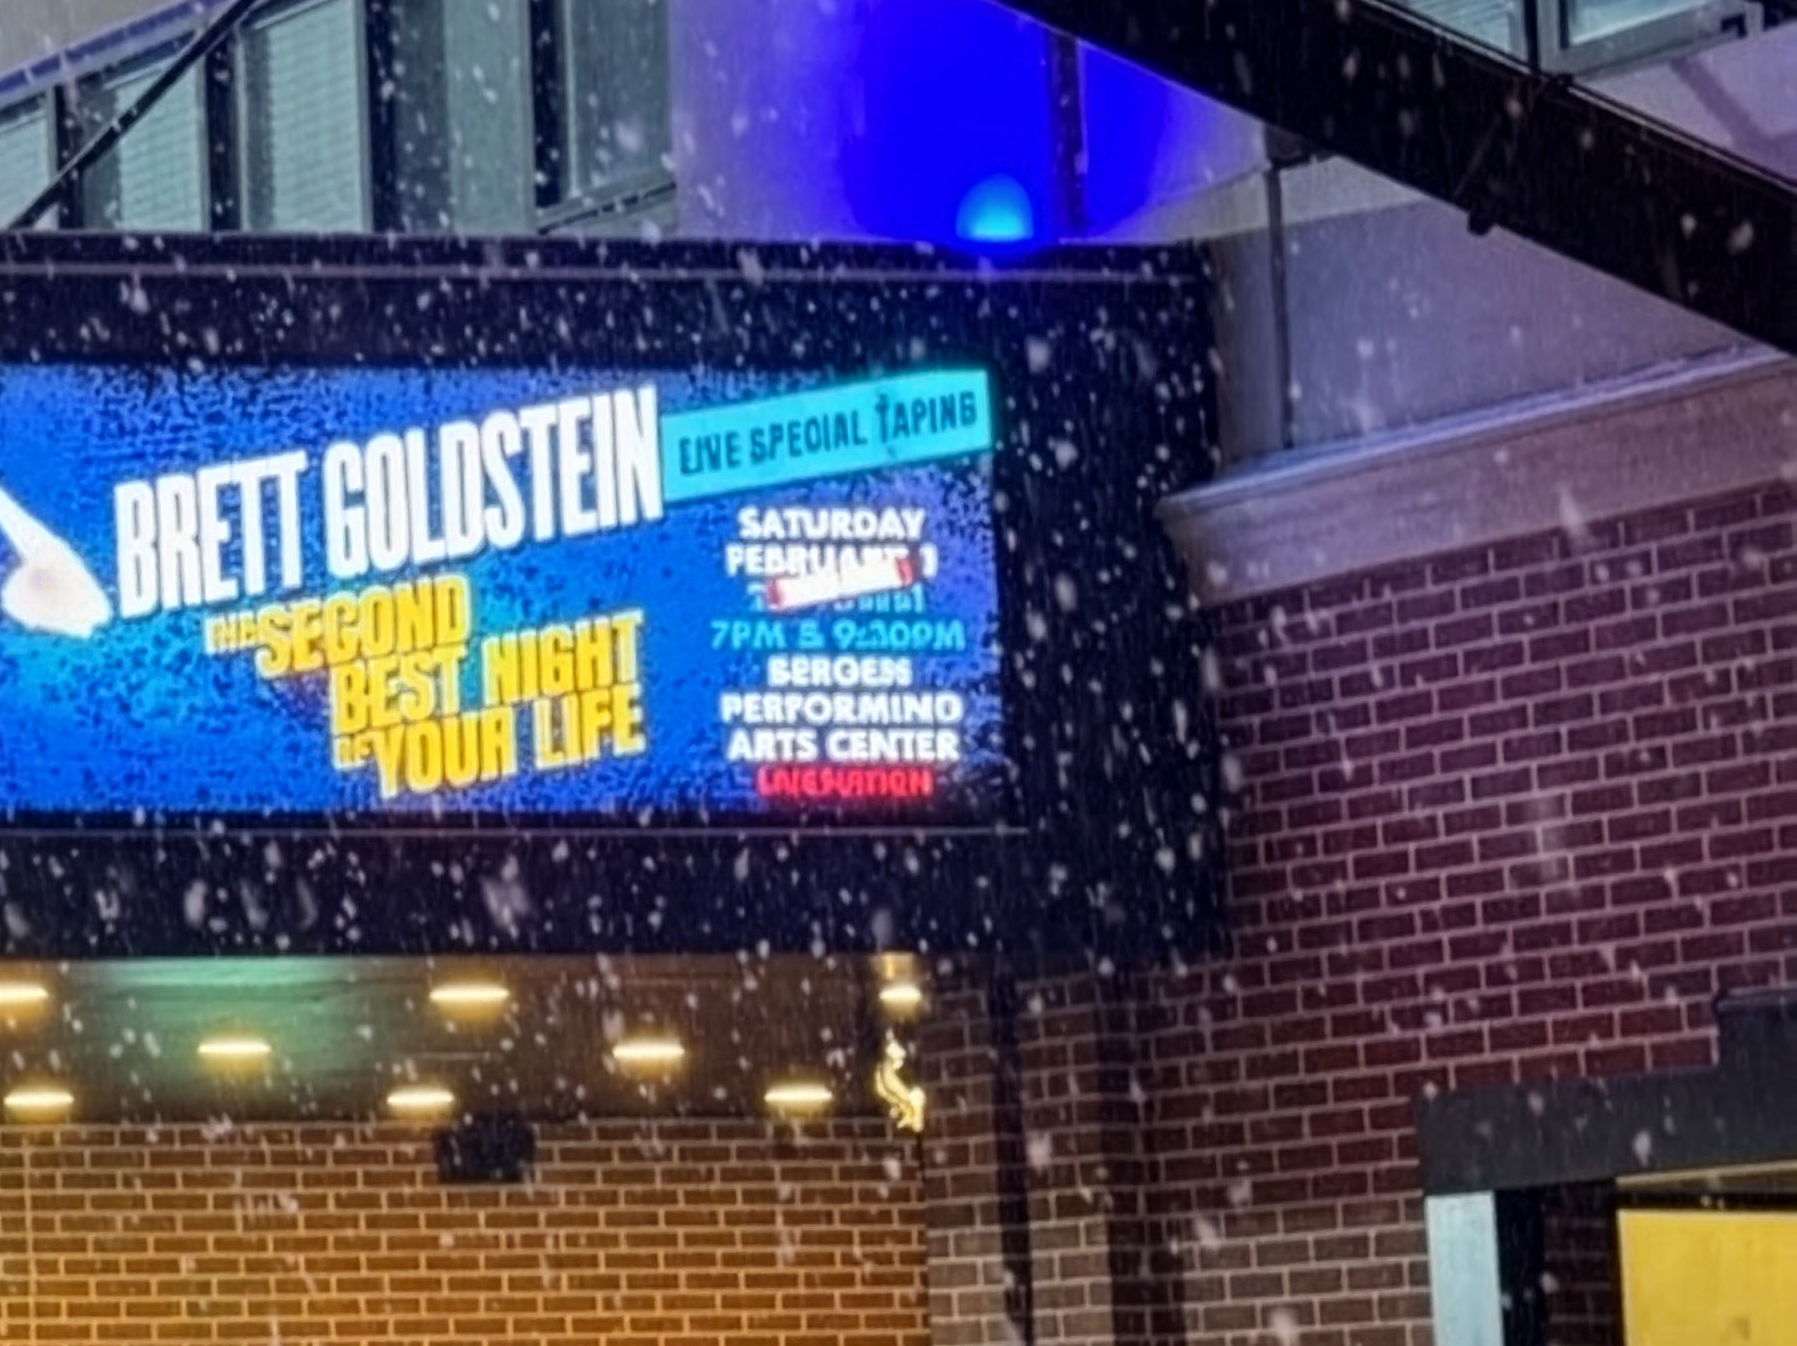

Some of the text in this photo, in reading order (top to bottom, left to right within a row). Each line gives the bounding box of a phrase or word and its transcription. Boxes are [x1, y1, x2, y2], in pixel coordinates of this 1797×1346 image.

[749, 409, 869, 465] SPECIAL
[875, 391, 978, 445] TAPING
[113, 383, 664, 619] BRETT GOLDSTEIN
[737, 506, 926, 541] SATURDAY
[254, 571, 472, 678] SECOND
[710, 619, 786, 651] 7PM
[330, 607, 644, 736] BEST NIGHT
[369, 706, 518, 799] YOUR
[533, 682, 647, 770] LIFE
[727, 729, 961, 762] ARTS CENTER
